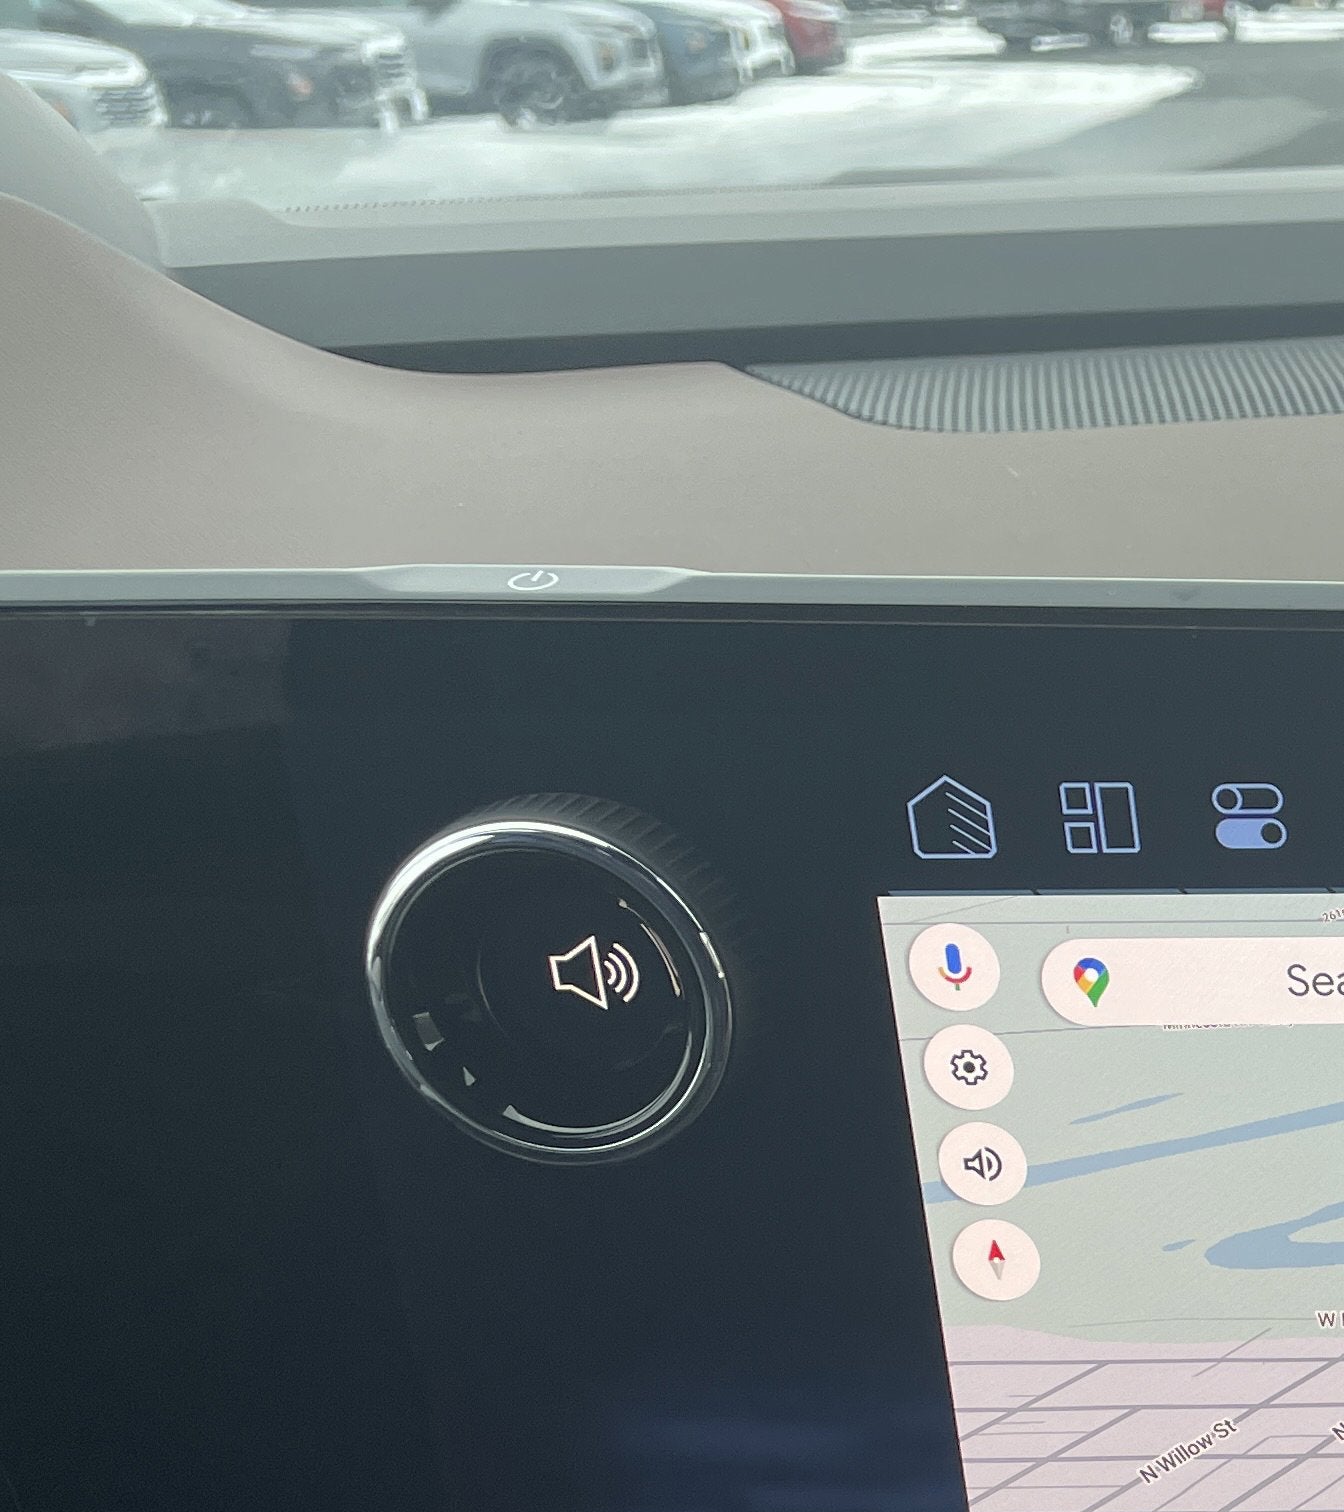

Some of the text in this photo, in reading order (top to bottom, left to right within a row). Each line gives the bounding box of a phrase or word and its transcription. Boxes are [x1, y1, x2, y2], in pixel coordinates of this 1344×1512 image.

[1317, 1312, 1335, 1328] W
[1139, 1418, 1237, 1483] N Willow St
